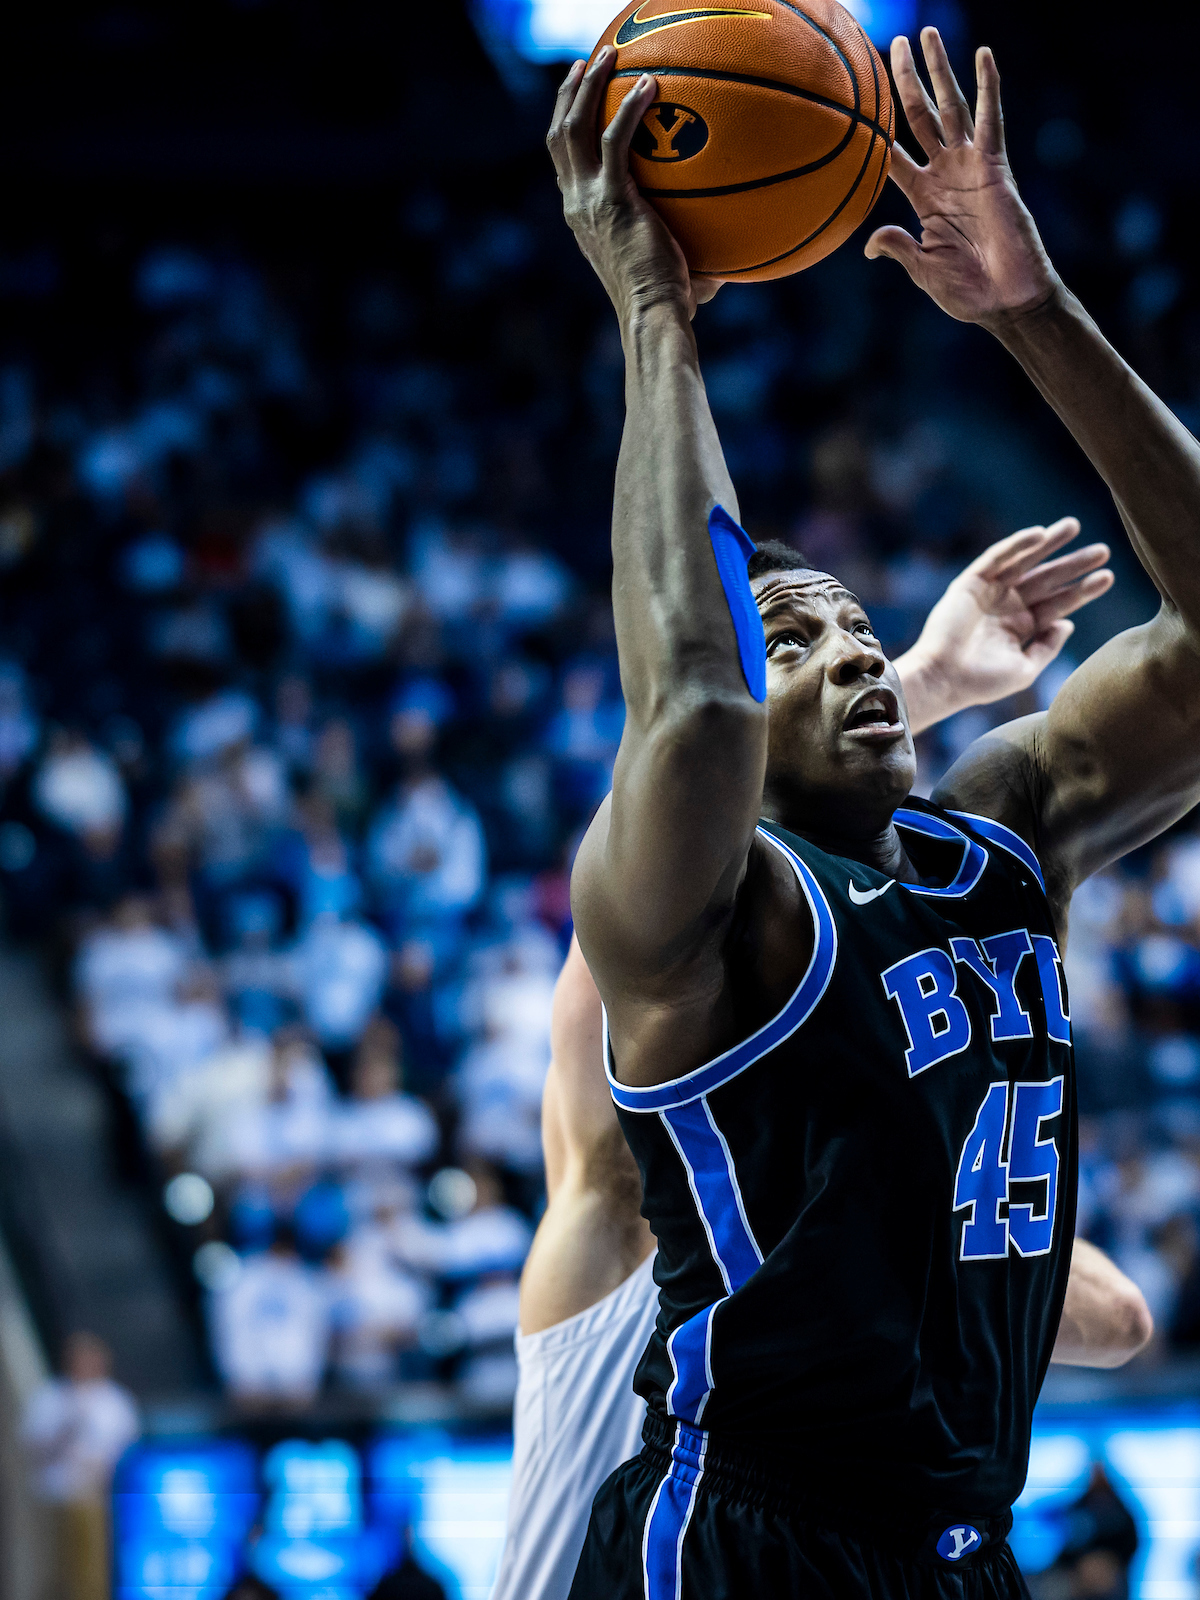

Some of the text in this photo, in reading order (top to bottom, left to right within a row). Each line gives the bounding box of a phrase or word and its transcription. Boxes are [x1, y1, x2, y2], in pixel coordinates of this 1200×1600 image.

[642, 107, 697, 158] Y
[952, 1074, 1065, 1262] 45
[947, 1527, 979, 1559] Y
